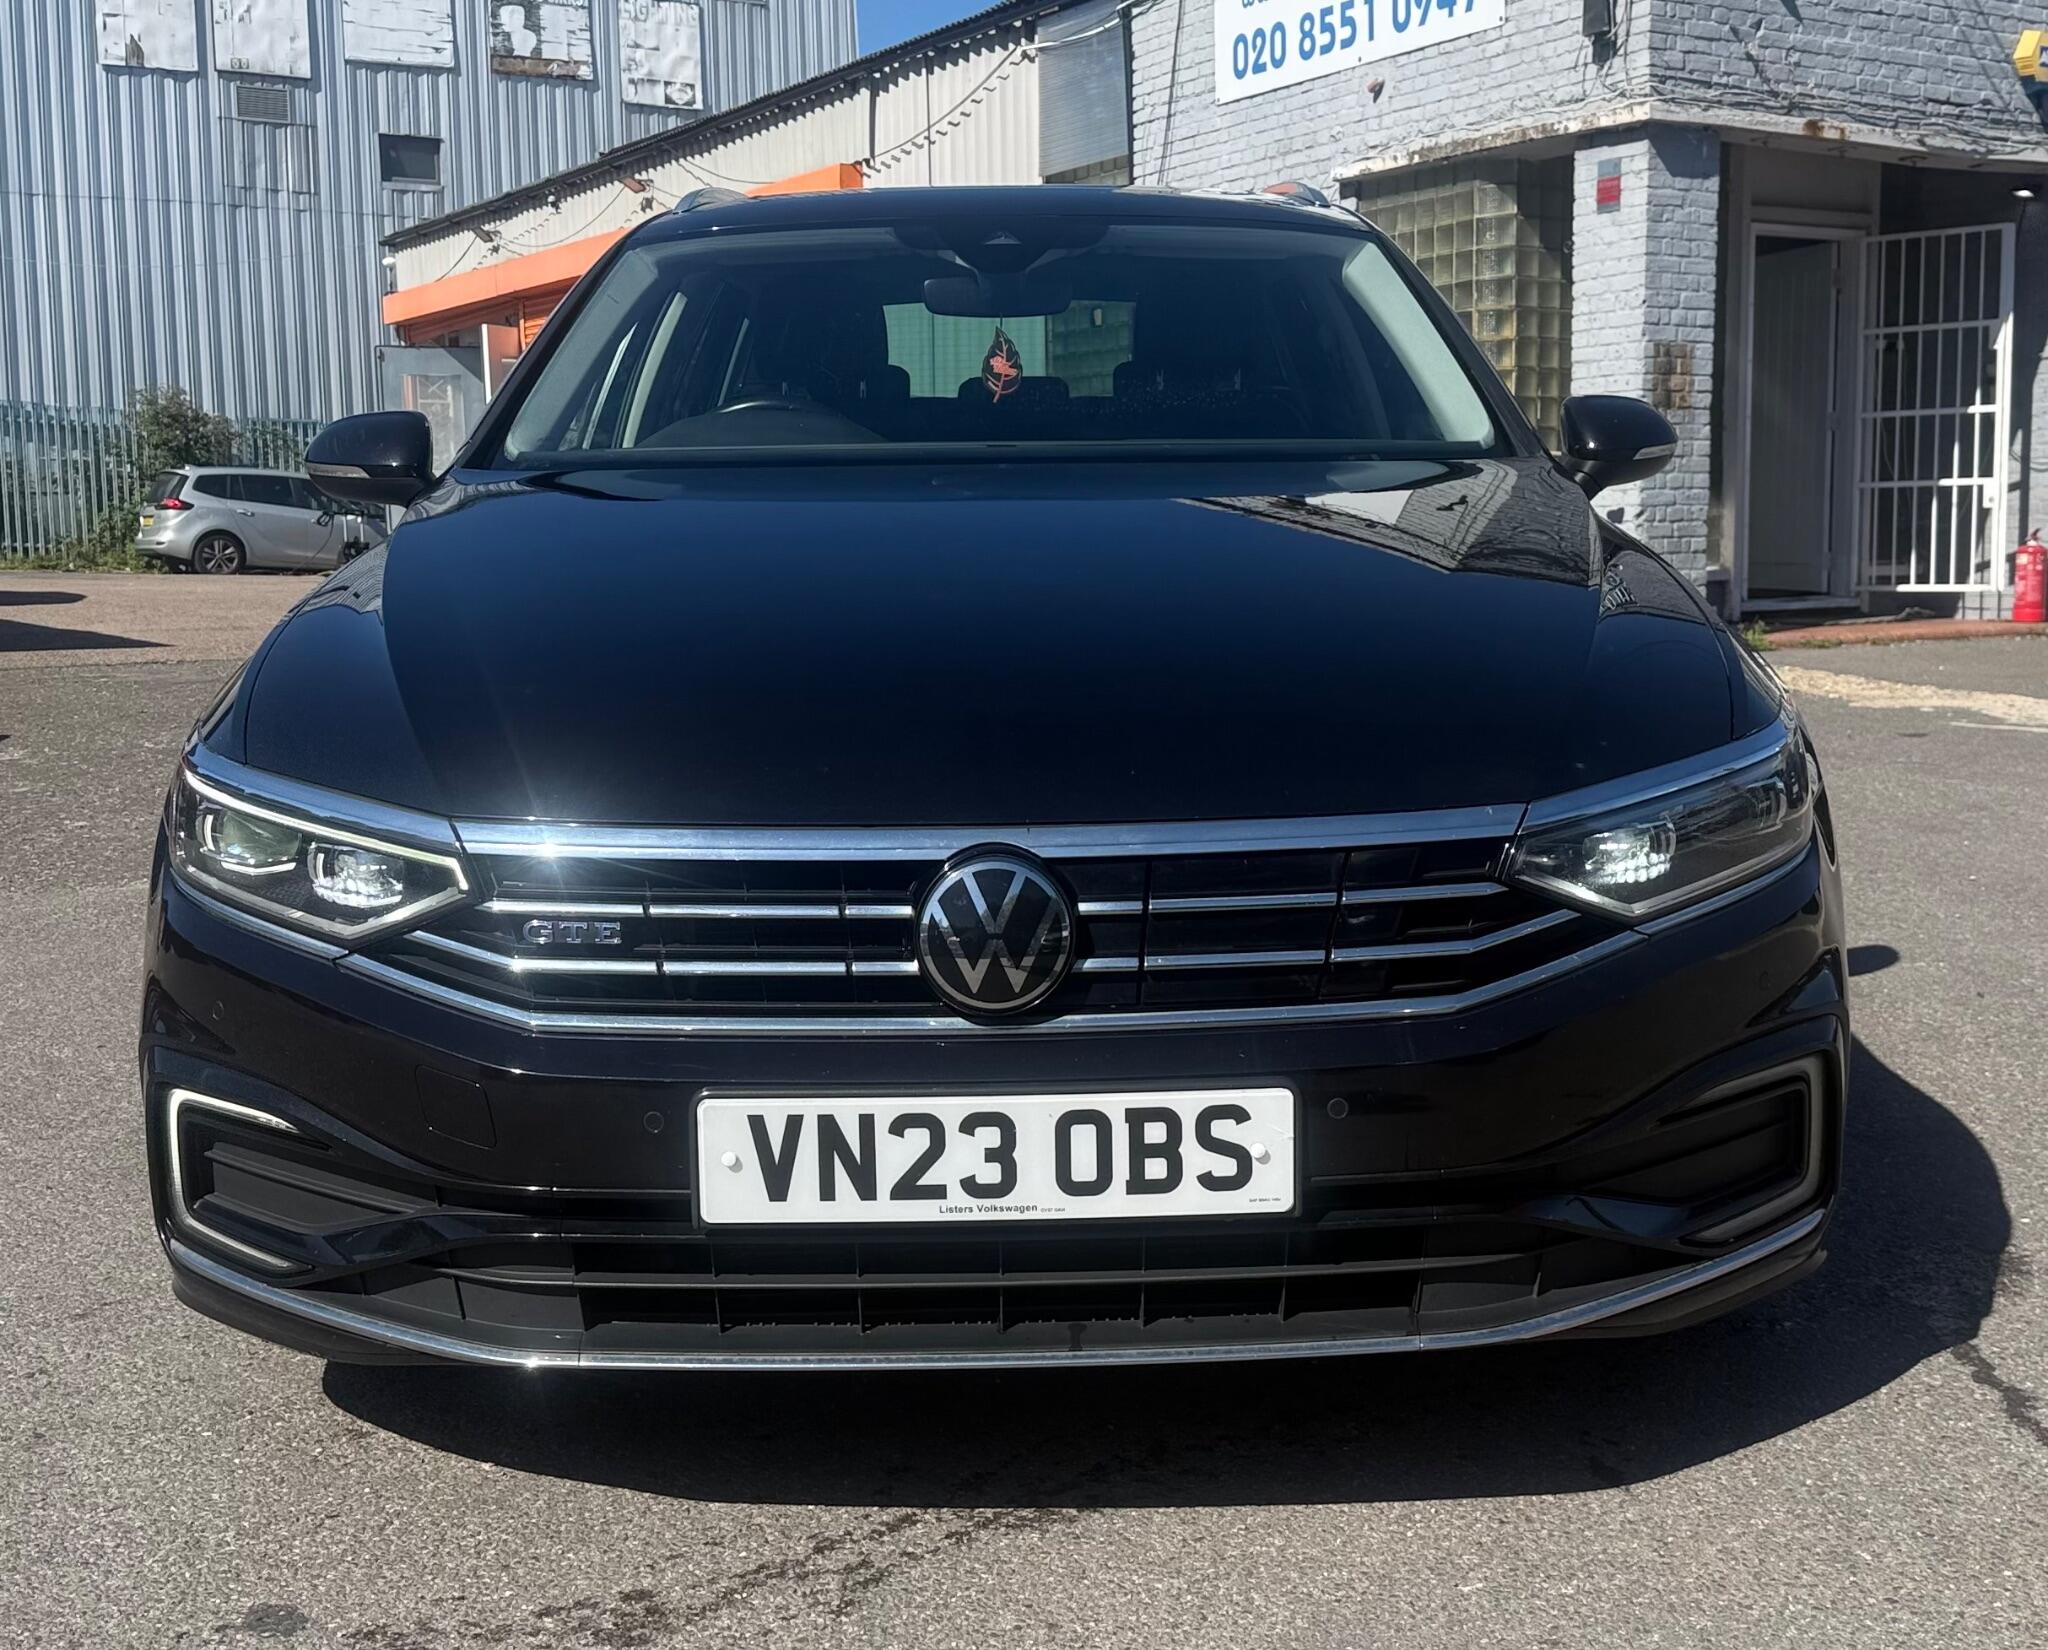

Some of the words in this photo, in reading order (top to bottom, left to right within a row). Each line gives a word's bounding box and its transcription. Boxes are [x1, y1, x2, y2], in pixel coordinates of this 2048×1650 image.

[1233, 21, 1287, 80] 020
[1299, 0, 1375, 62] 8551
[1392, 0, 1474, 34] 09
[522, 919, 622, 944] GTE
[747, 1111, 1018, 1202] VN23
[1055, 1103, 1253, 1196] OBS
[939, 1205, 974, 1215] Listers
[976, 1203, 1039, 1216] Volkswagen
